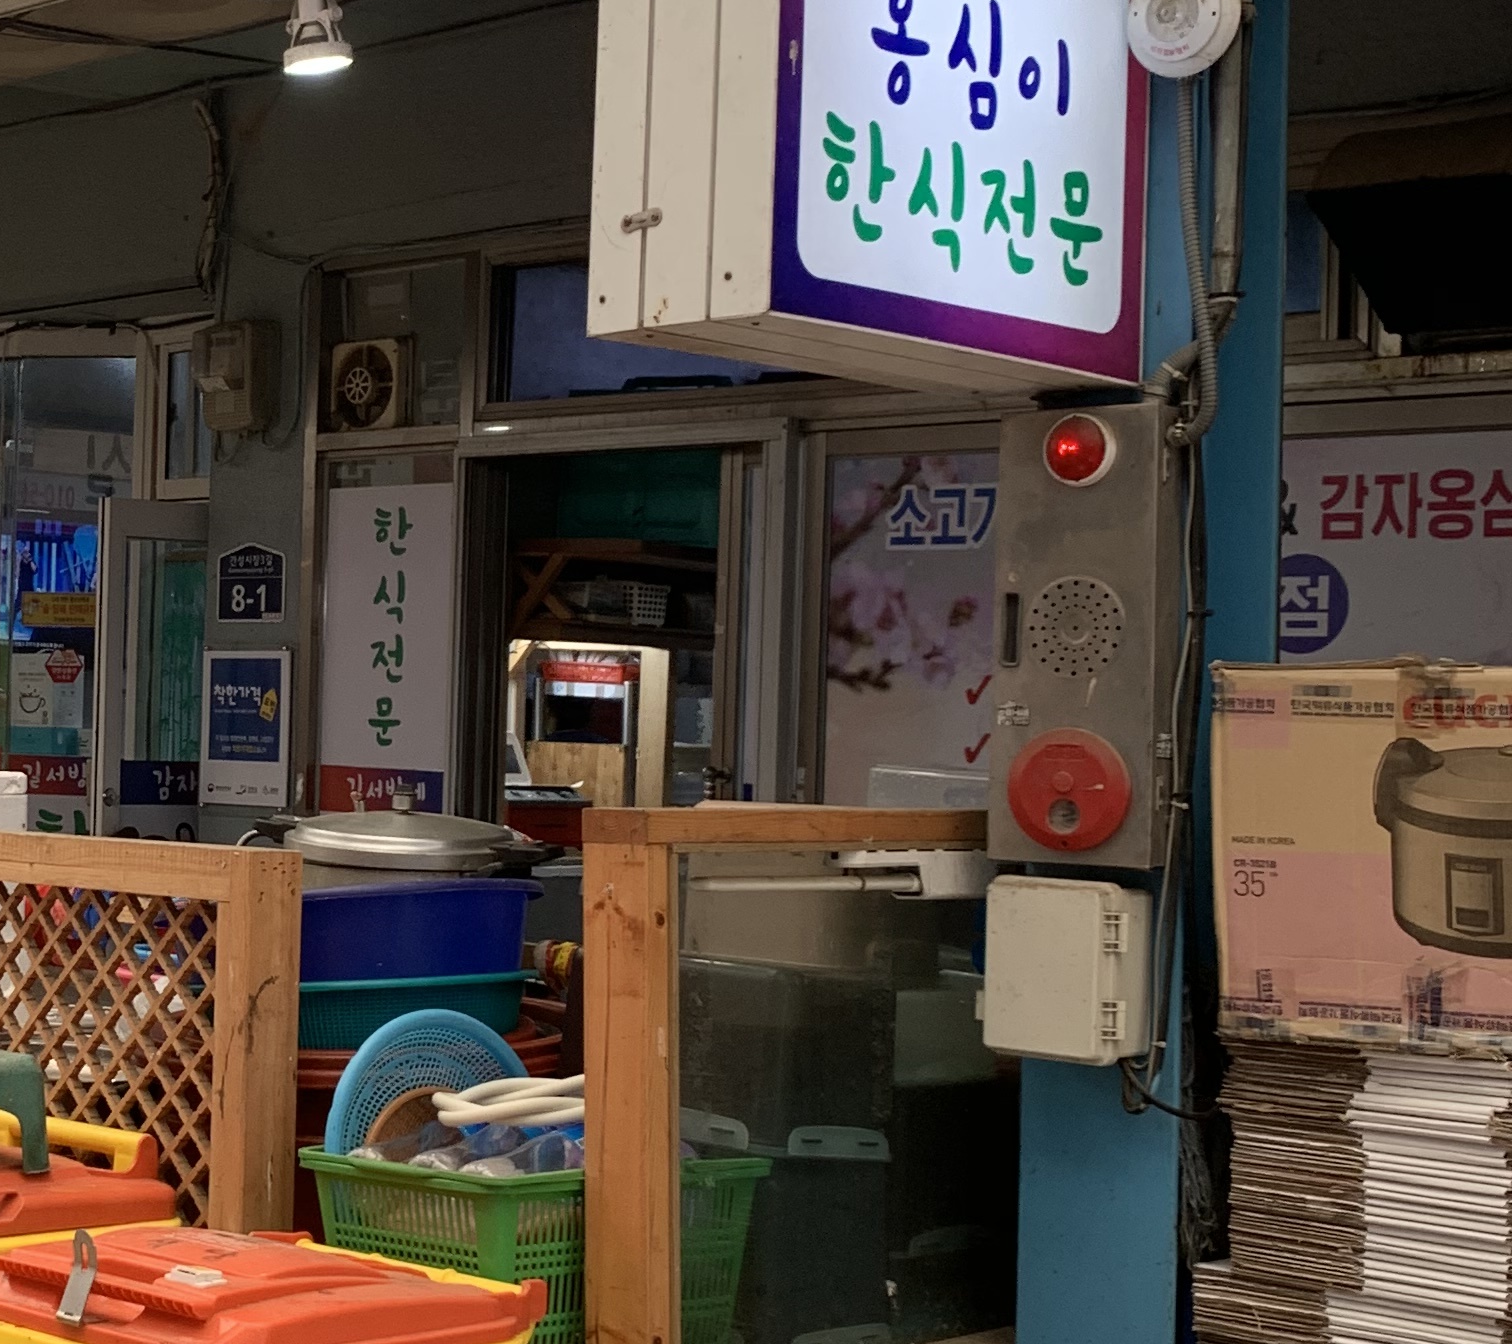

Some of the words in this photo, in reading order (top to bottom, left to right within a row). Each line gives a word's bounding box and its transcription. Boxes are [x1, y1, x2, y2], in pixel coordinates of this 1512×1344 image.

[821, 111, 1104, 287] 한식전문
[231, 584, 267, 613] 8-1
[368, 506, 413, 748] 한식전문
[213, 684, 262, 707] 착한가격
[1231, 835, 1256, 844] MADE
[1257, 836, 1266, 845] IN
[1267, 837, 1296, 846] KOREA
[1233, 870, 1266, 898] 35
